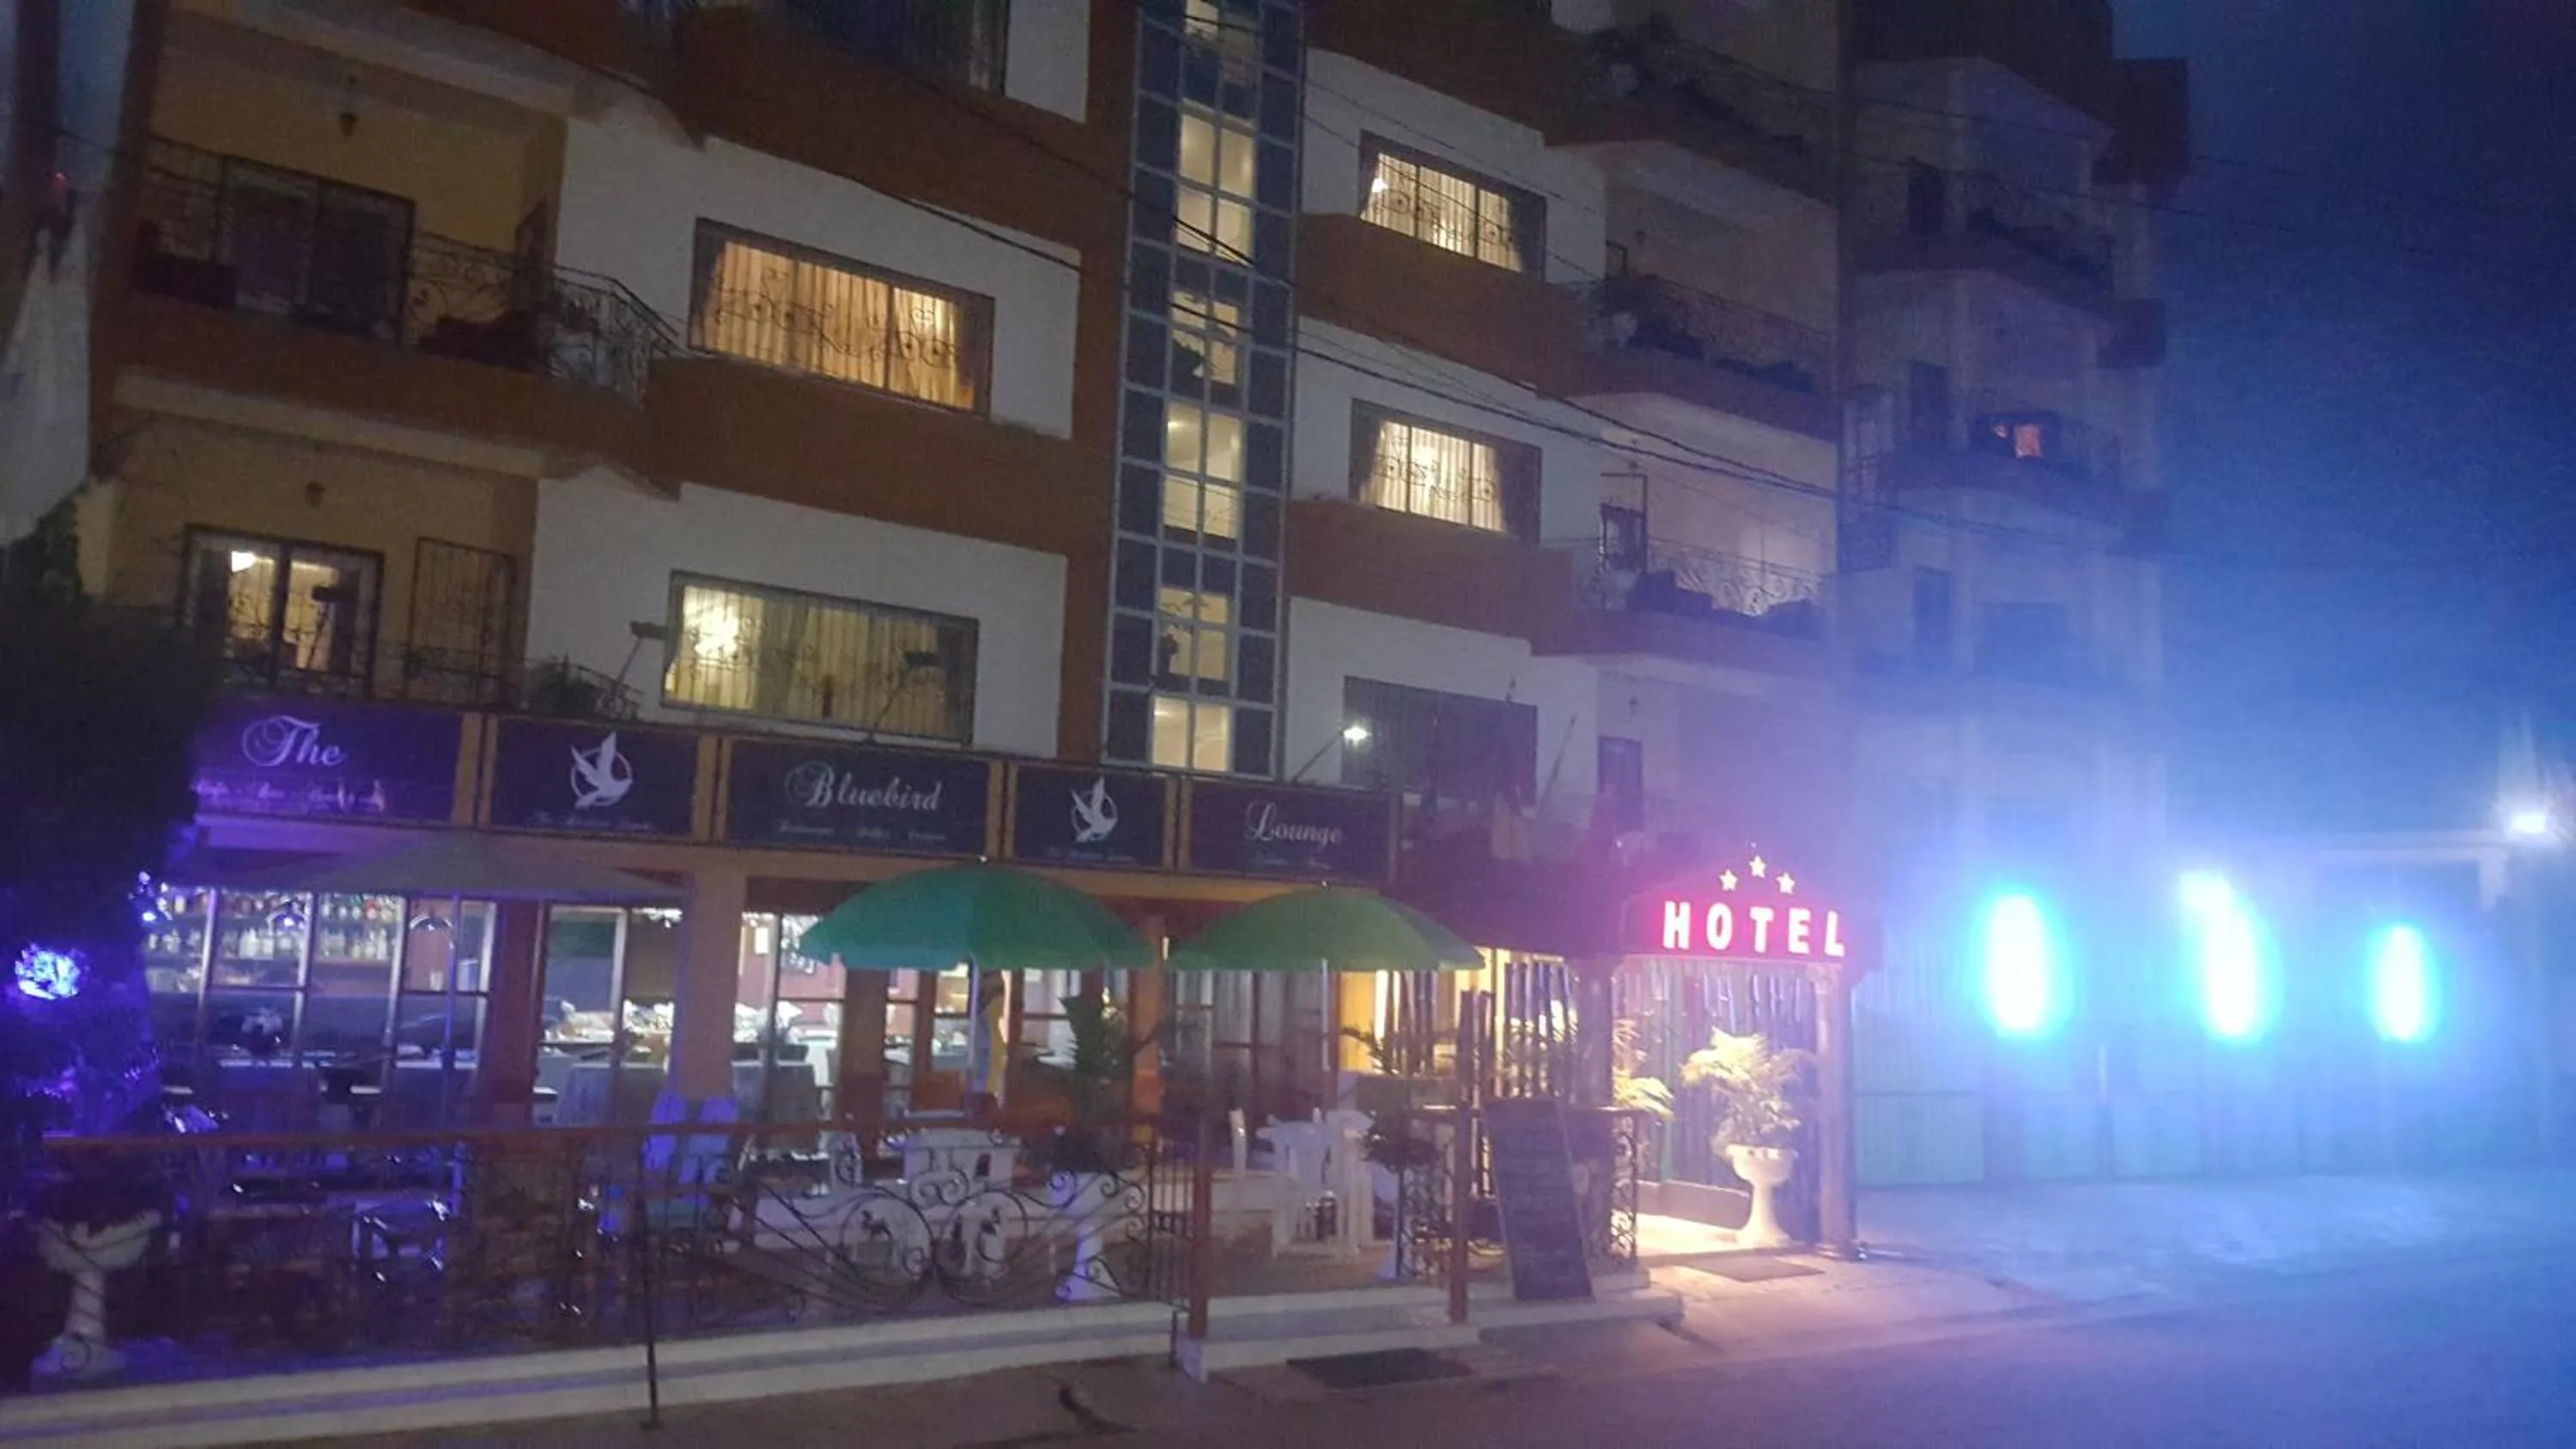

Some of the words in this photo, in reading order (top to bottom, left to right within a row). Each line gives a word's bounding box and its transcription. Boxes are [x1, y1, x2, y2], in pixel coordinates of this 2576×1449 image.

[241, 714, 346, 767] The
[785, 760, 943, 811] Bluebird
[1244, 800, 1343, 853] Lounge
[1662, 900, 1845, 957] HOTEL
